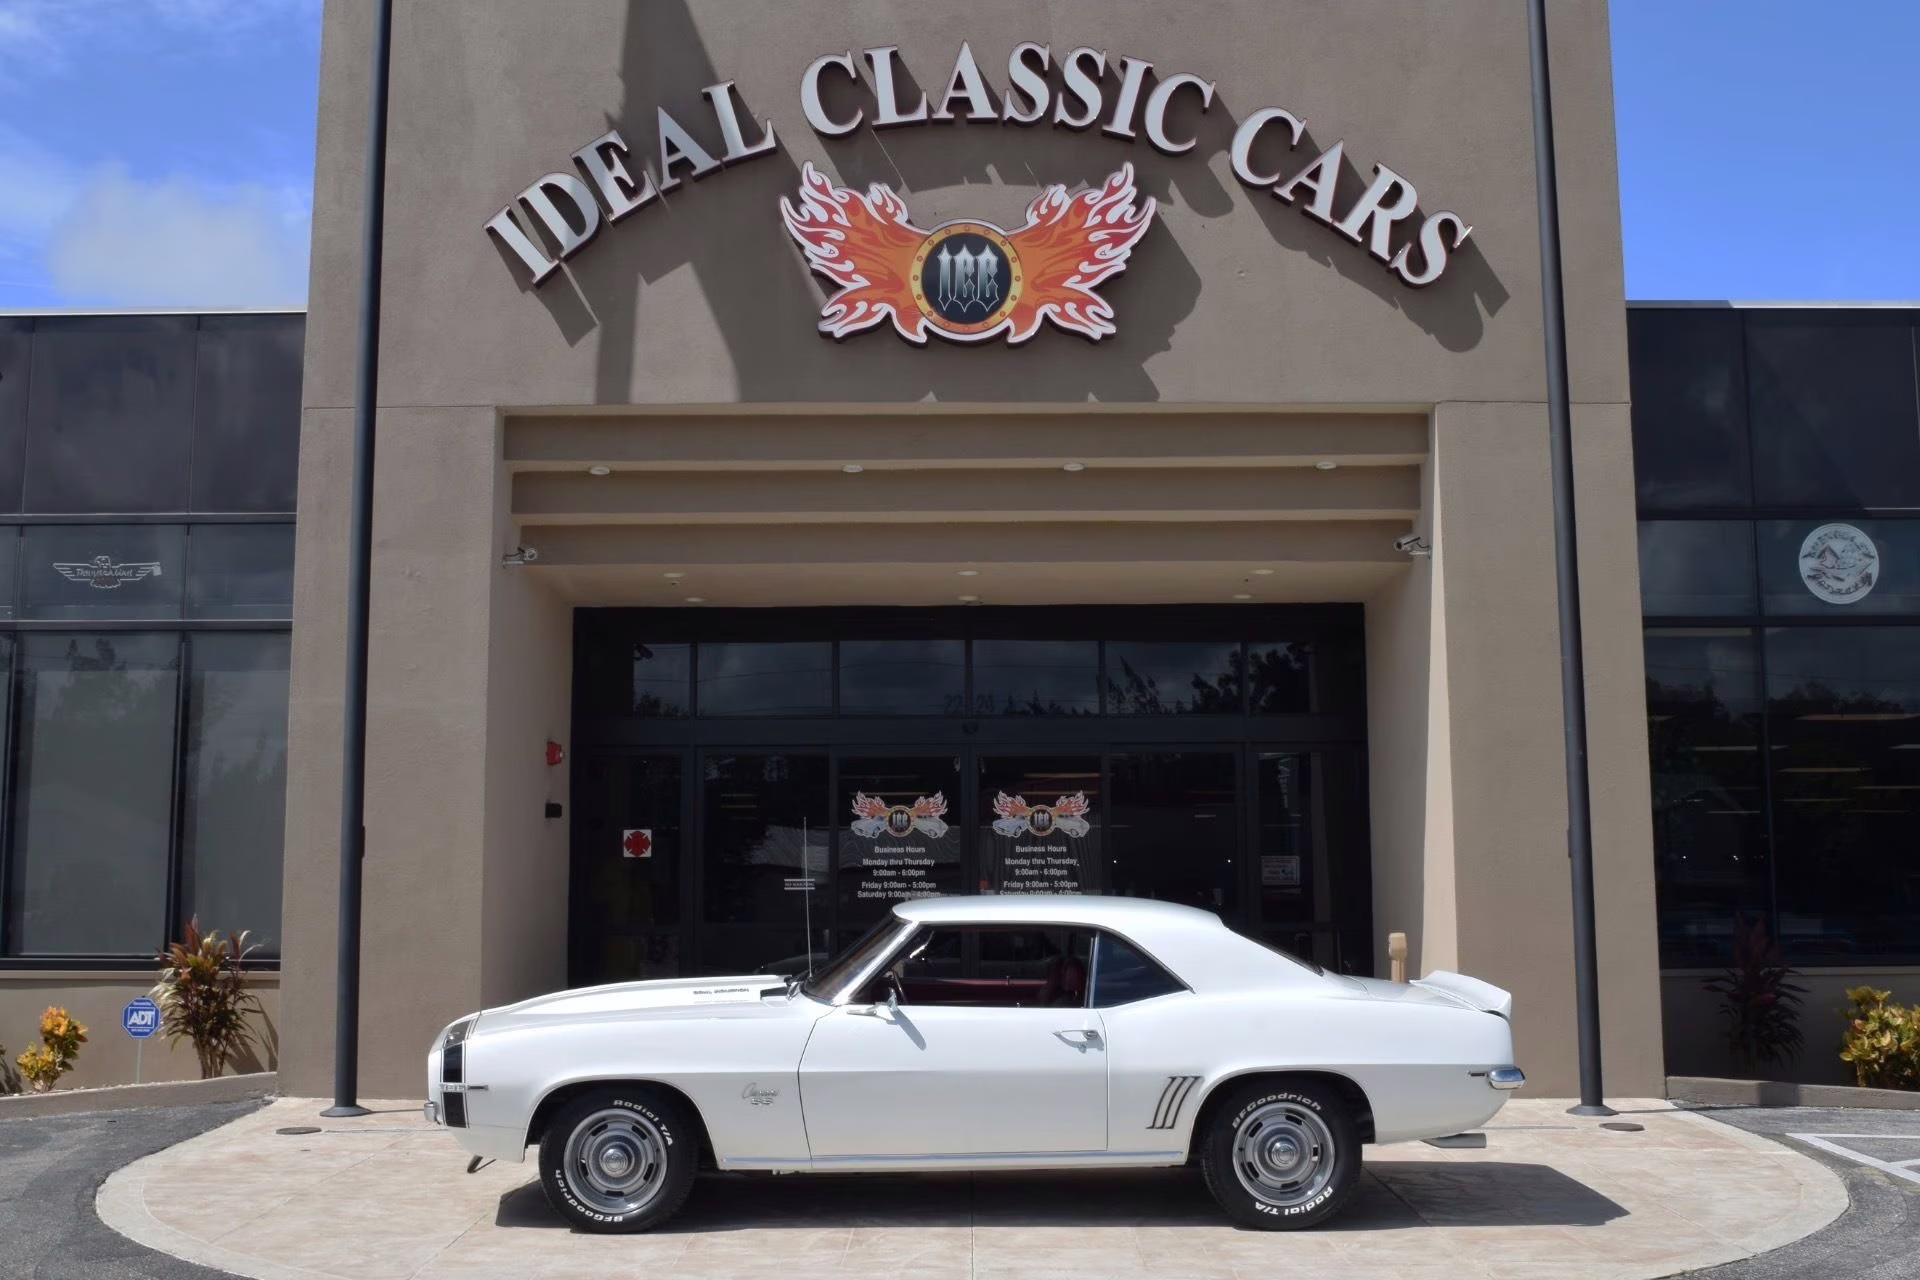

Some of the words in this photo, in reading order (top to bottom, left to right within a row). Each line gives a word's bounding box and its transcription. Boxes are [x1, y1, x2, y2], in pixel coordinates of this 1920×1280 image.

[482, 79, 777, 288] IDEAL
[800, 39, 1216, 155] CLASSIC
[1230, 106, 1474, 289] CARS
[1015, 845, 1045, 853] Business
[1047, 845, 1067, 853] Hours
[862, 858, 888, 867] Monday
[889, 858, 902, 866] thru
[904, 858, 935, 867] Thursday
[1004, 858, 1030, 866] Monday
[902, 869, 926, 877] 6:00pm
[1043, 868, 1068, 877] 6:00pm
[861, 881, 882, 890] Friday
[883, 881, 907, 889] 9:00am
[912, 881, 937, 890] 5:00pm
[1003, 881, 1024, 889] Friday
[1053, 881, 1078, 889] 5:00pm
[857, 890, 887, 899] Saturday
[128, 1010, 155, 1025] ADT
[1231, 1092, 1322, 1129] BFGoodrich
[555, 1169, 625, 1223] BFGoodrich
[1284, 1185, 1334, 1216] Radial
[1254, 1201, 1280, 1216] T/A
